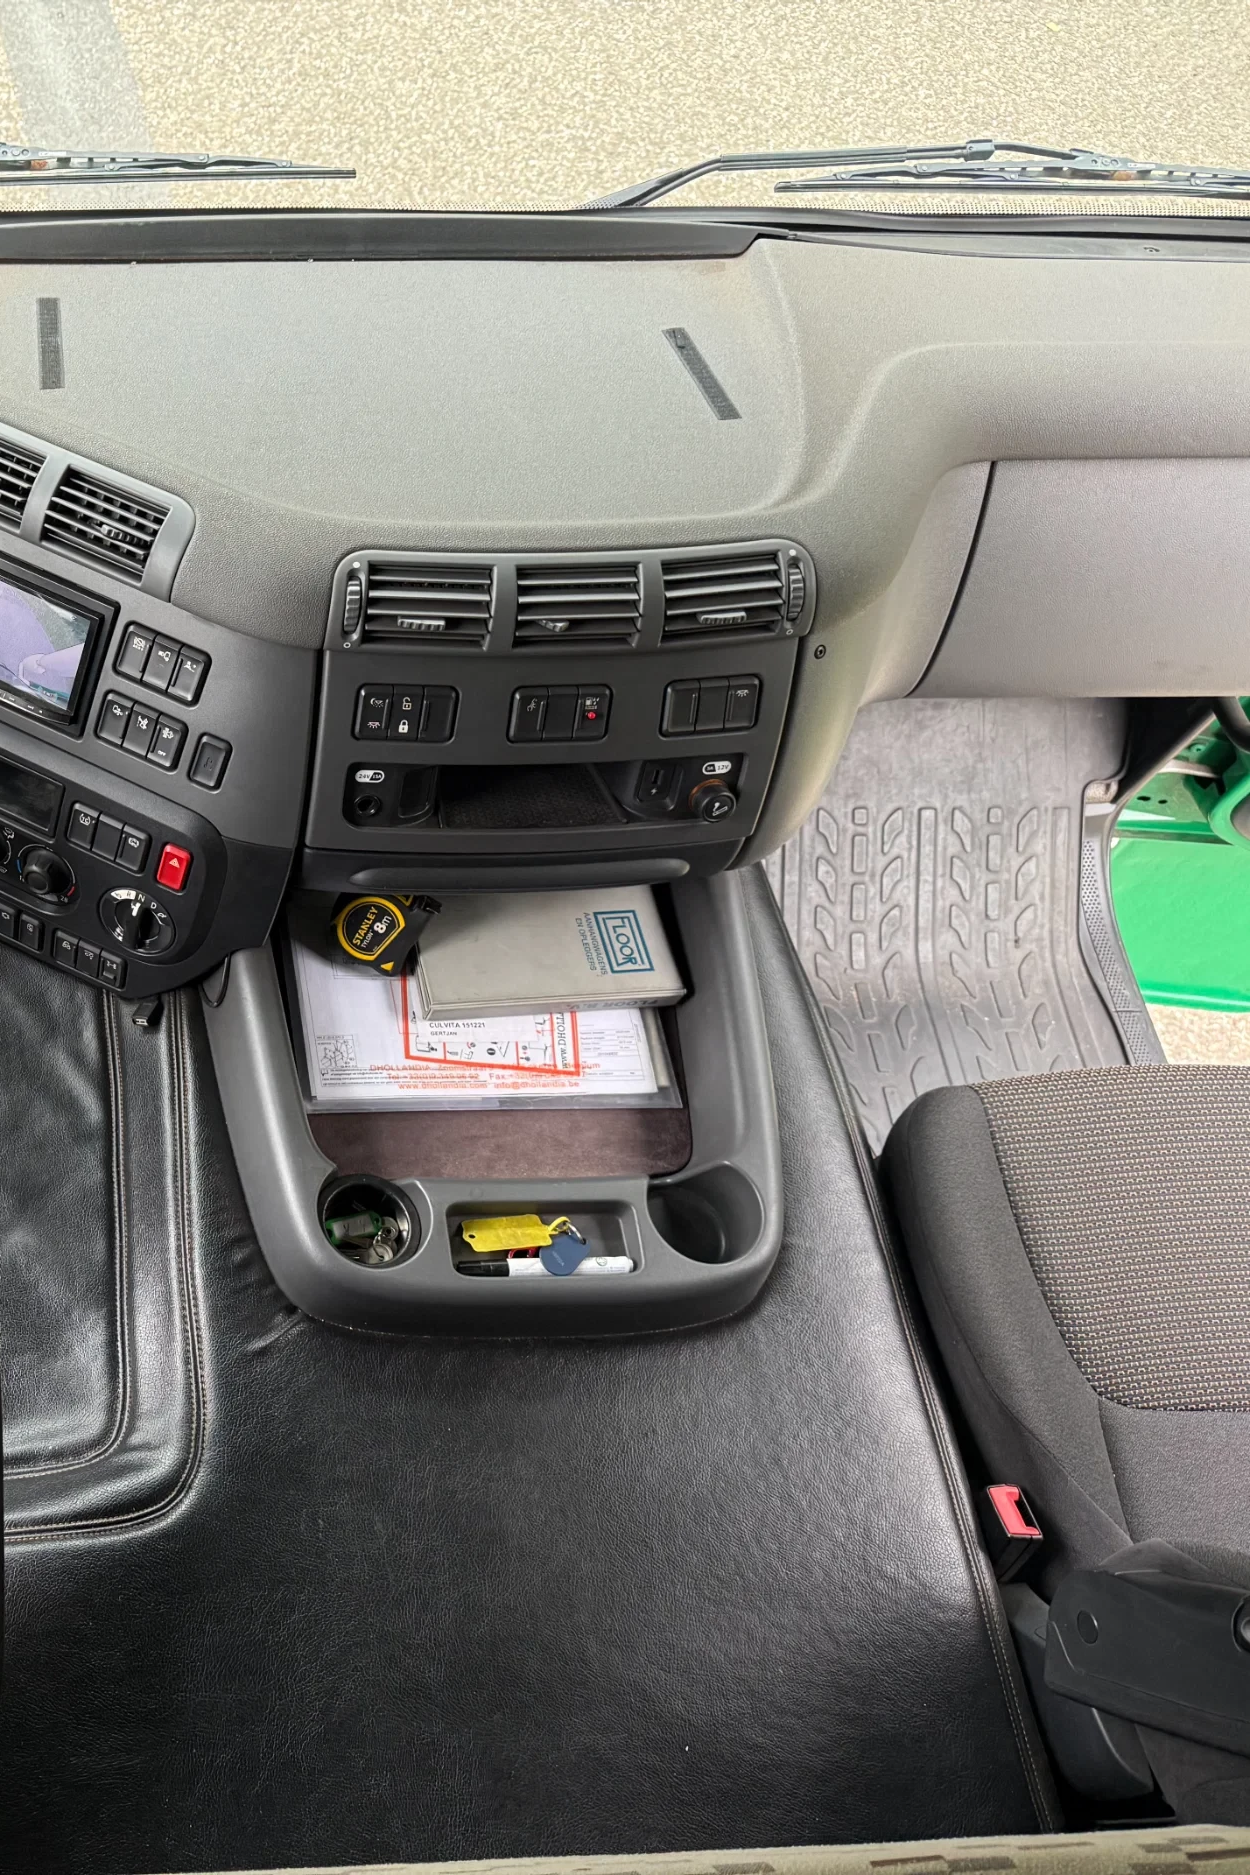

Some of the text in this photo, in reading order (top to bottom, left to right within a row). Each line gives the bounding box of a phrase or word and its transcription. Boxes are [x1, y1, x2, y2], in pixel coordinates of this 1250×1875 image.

[137, 893, 146, 902] N
[150, 901, 157, 909] D
[352, 906, 378, 946] STANLEY
[373, 915, 392, 934] 8m
[575, 917, 597, 972] EN OPLEGGERS
[583, 912, 608, 976] AANHANGWAGENS
[602, 916, 645, 967] FLOOR
[603, 999, 658, 1008] FLOOR
